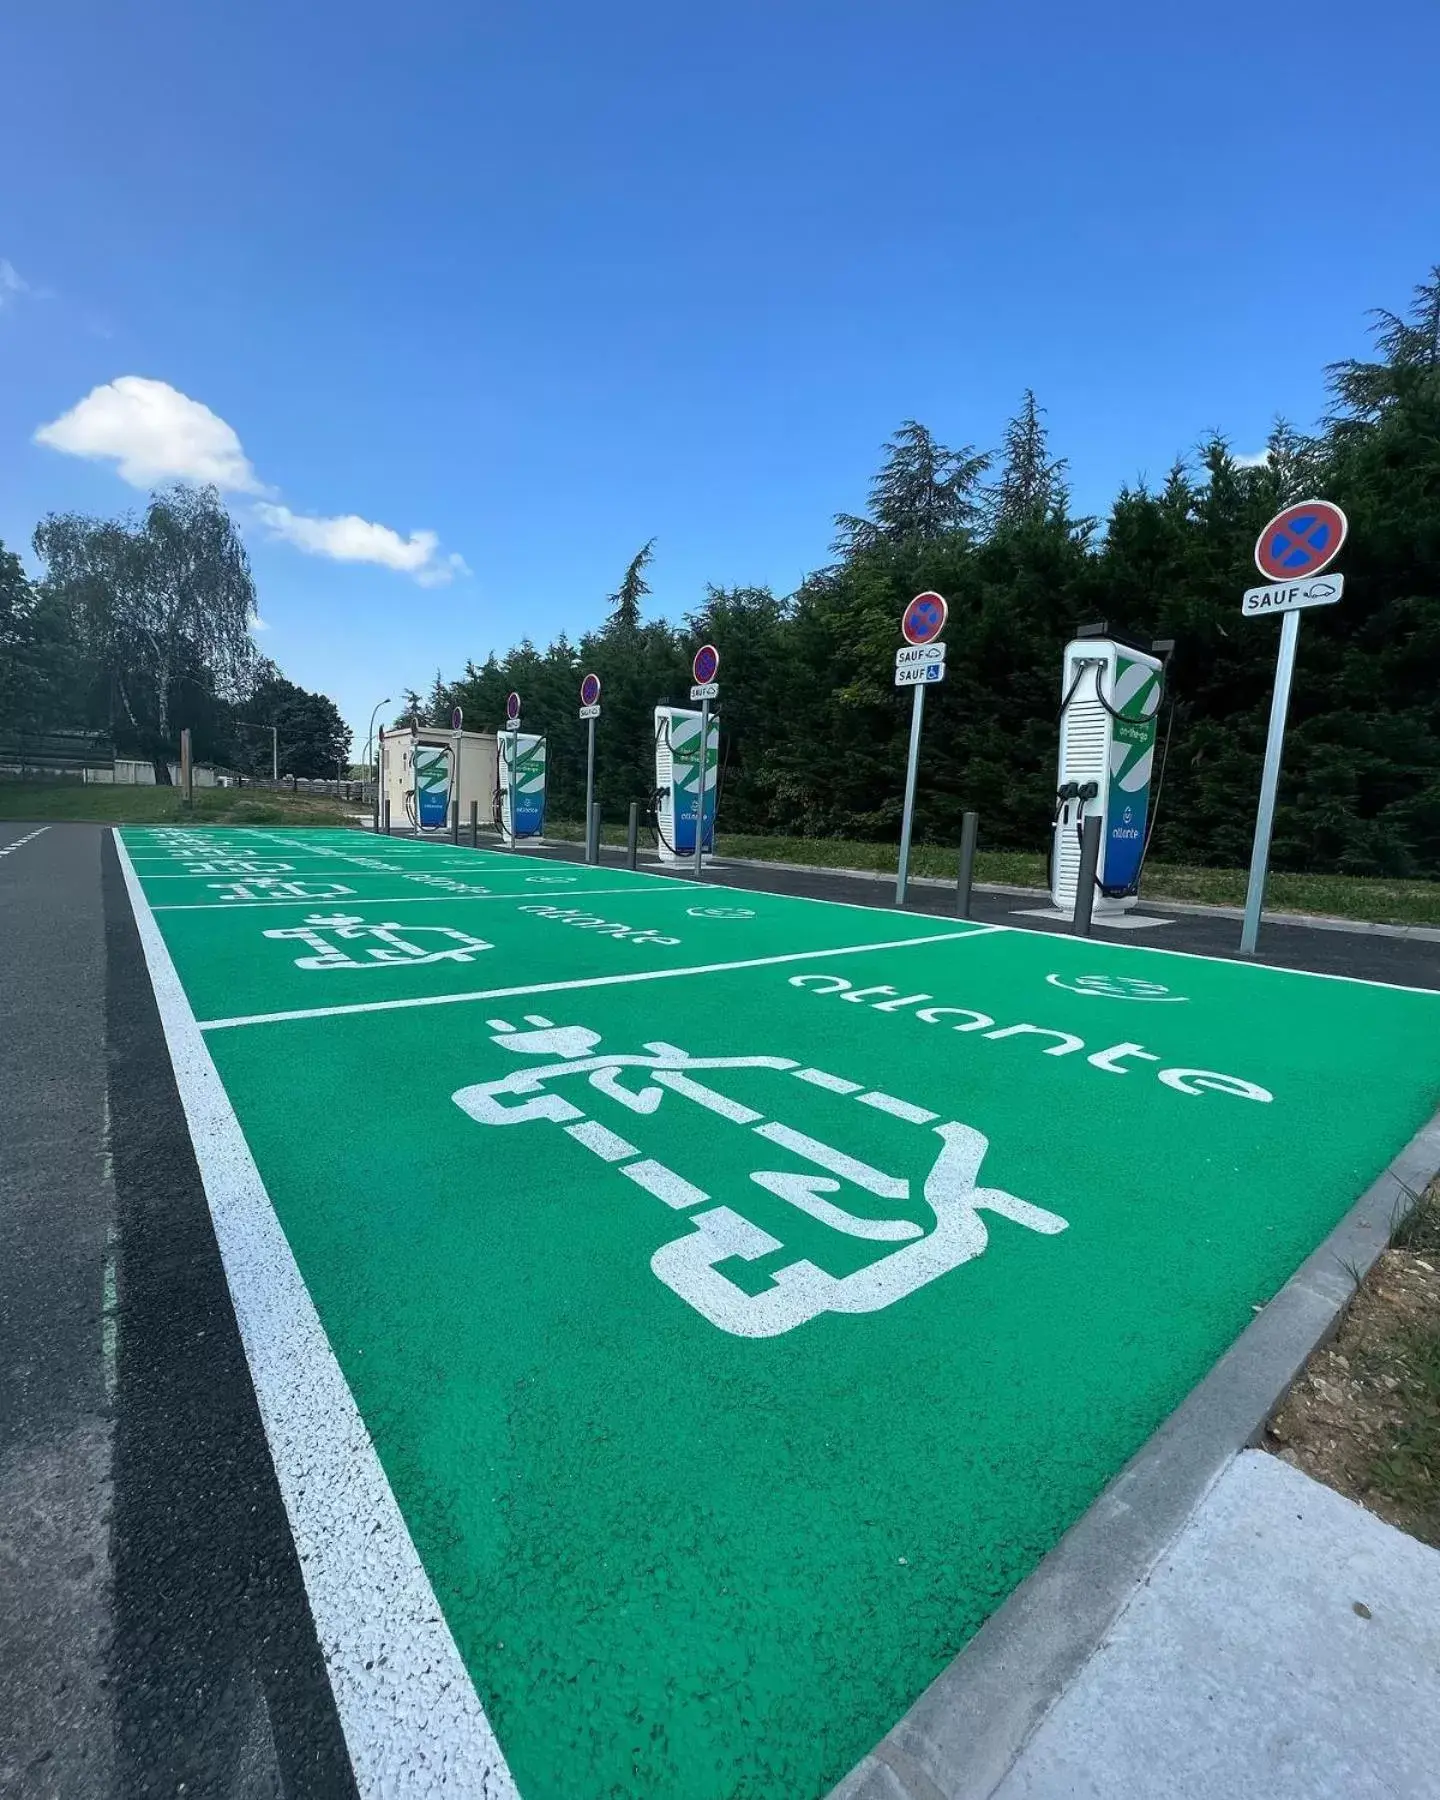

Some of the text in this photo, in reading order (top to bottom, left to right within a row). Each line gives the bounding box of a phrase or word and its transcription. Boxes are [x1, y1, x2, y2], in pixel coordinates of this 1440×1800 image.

[1247, 588, 1300, 609] SAUF
[898, 650, 924, 663] SAUF
[899, 669, 926, 681] SAUF
[518, 905, 681, 945] atlante
[787, 974, 1275, 1104] atlante
